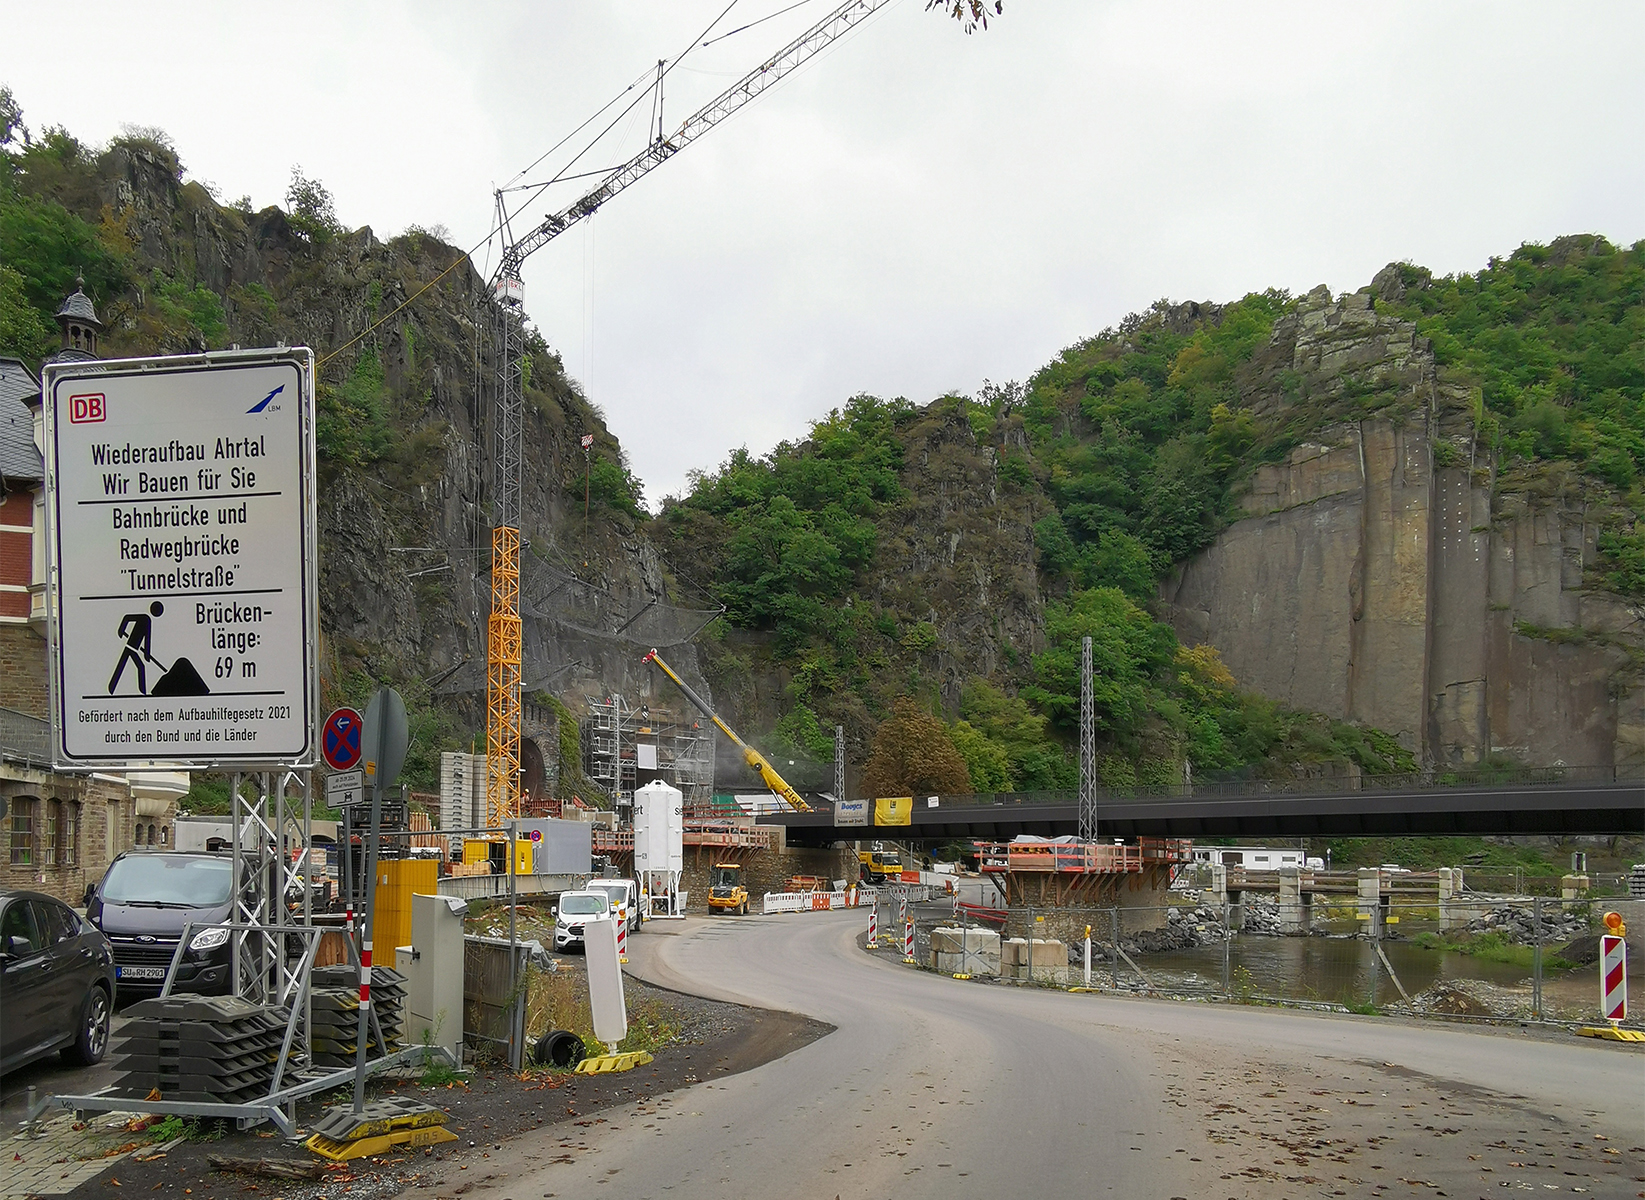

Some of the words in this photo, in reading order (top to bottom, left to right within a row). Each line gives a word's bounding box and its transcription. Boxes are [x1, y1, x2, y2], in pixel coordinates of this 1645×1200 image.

[74, 397, 102, 419] DB
[267, 404, 281, 412] LBM
[91, 440, 205, 466] Wiederaufbau
[214, 435, 266, 460] Ahrtal
[102, 473, 130, 495] Wir
[138, 471, 189, 494] Bauen
[197, 468, 222, 491] für
[230, 466, 256, 489] Sie
[113, 504, 209, 529] Bahnbrücke
[217, 502, 247, 525] und
[120, 533, 240, 563] Radwegbrücke
[196, 601, 272, 624] Brücken-
[212, 627, 261, 654] länge:
[215, 656, 233, 678] 69
[242, 661, 256, 677] m
[78, 709, 123, 723] Gefördert
[127, 709, 149, 722] nach
[154, 708, 174, 721] dem
[178, 706, 264, 723] Aufbauhilfegesetz
[268, 706, 291, 719] 2021
[105, 730, 131, 743] durch
[135, 730, 152, 743] den
[157, 729, 180, 742] Bund
[184, 729, 200, 742] und
[205, 729, 220, 741] die
[224, 728, 257, 741] Länder
[122, 968, 132, 976] SU
[136, 968, 146, 976] RH
[147, 969, 164, 977] 2901
